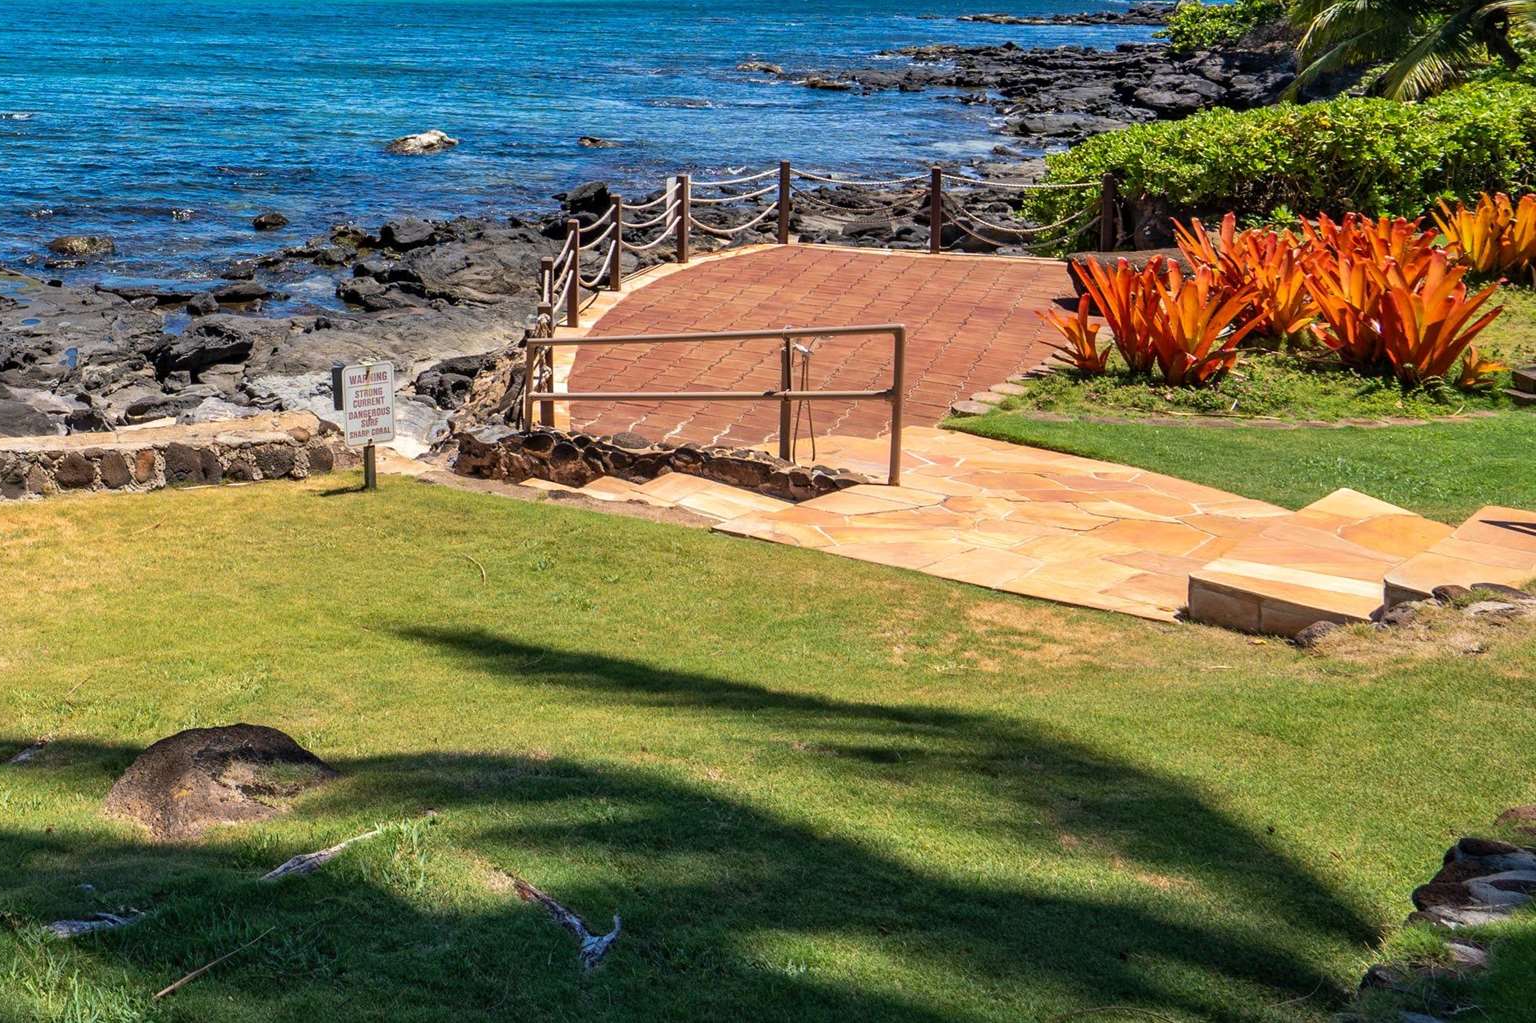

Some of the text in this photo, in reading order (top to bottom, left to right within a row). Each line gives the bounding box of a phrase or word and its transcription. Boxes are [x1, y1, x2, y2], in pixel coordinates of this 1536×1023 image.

[354, 387, 383, 398] STRONG
[353, 396, 385, 408] CURRENT
[348, 406, 390, 420] DANGEROUS
[360, 417, 379, 427] SURF
[349, 426, 391, 439] SHARP CORAL
